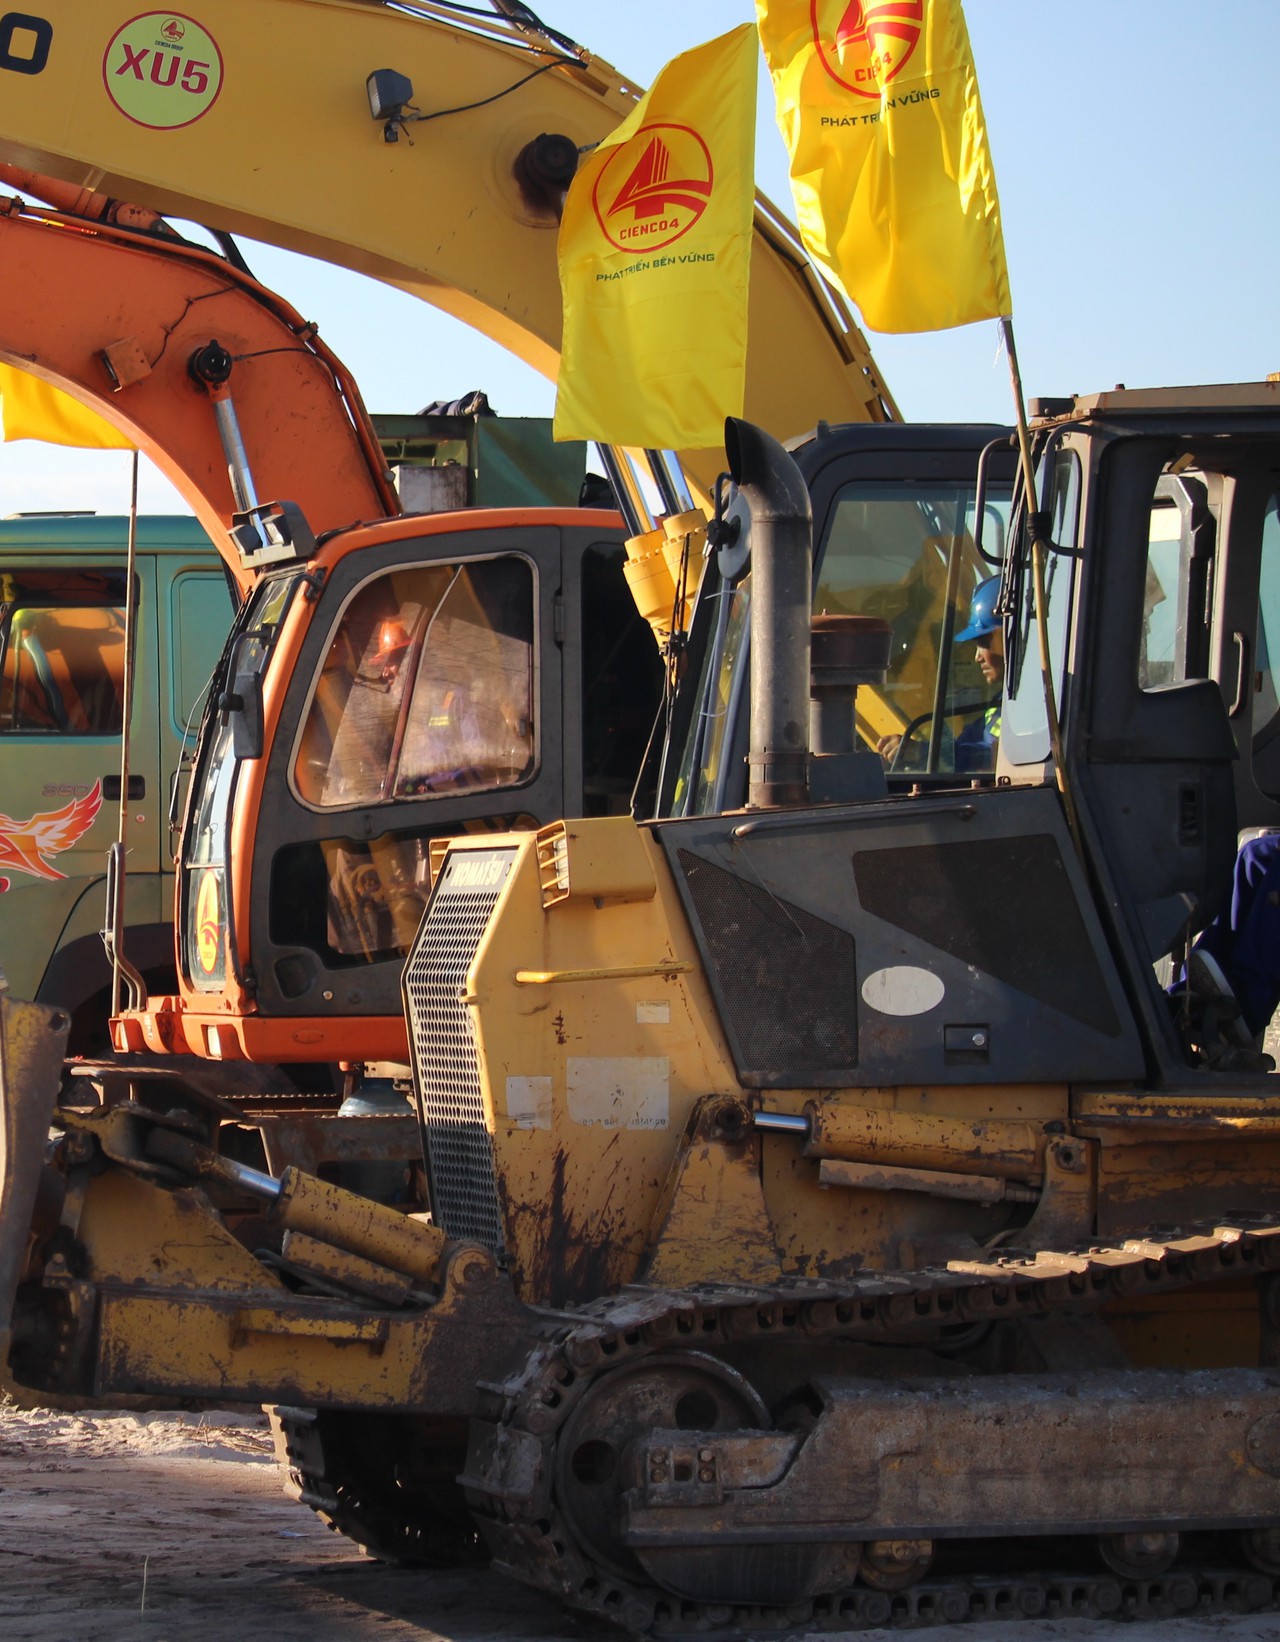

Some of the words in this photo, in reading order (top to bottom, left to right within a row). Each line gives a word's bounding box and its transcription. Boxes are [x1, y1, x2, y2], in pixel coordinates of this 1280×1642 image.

[115, 43, 210, 94] XU5
[620, 218, 680, 240] CIENCO4
[449, 853, 506, 887] KOMATSU
